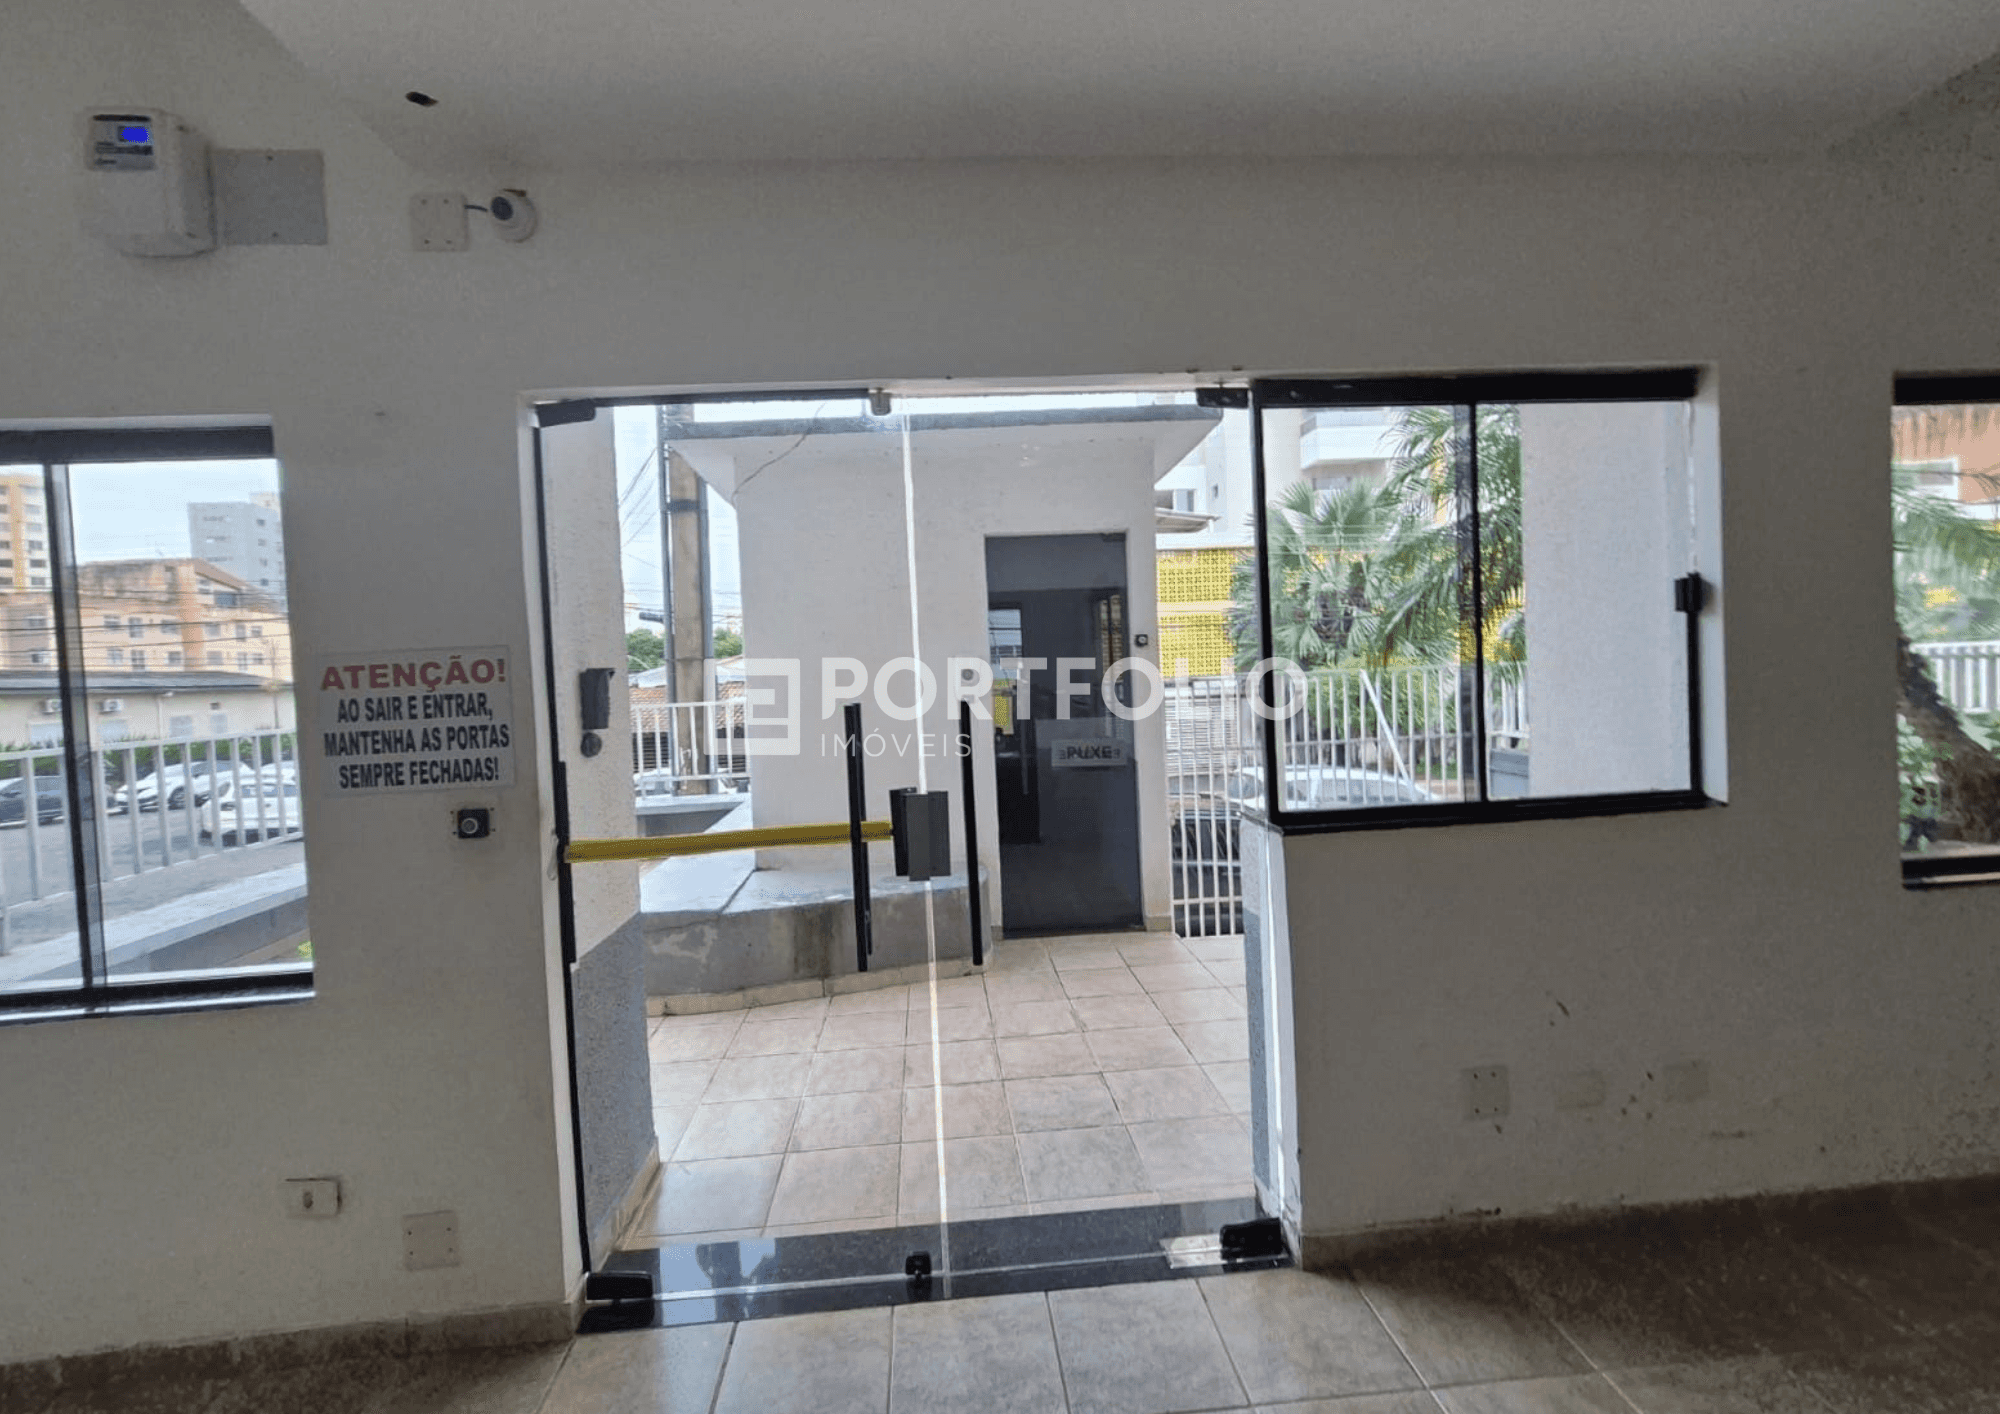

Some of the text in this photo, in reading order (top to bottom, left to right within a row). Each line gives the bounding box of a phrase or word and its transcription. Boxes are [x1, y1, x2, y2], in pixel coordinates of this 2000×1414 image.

[321, 655, 506, 692] ATENÇÃO!
[337, 692, 493, 723] AO SAIR E ENTRAR,
[324, 724, 510, 757] MANTENHA AS PORTAS
[1066, 745, 1113, 760] PUXE
[339, 757, 500, 789] SEMPRE FECHADAS!
